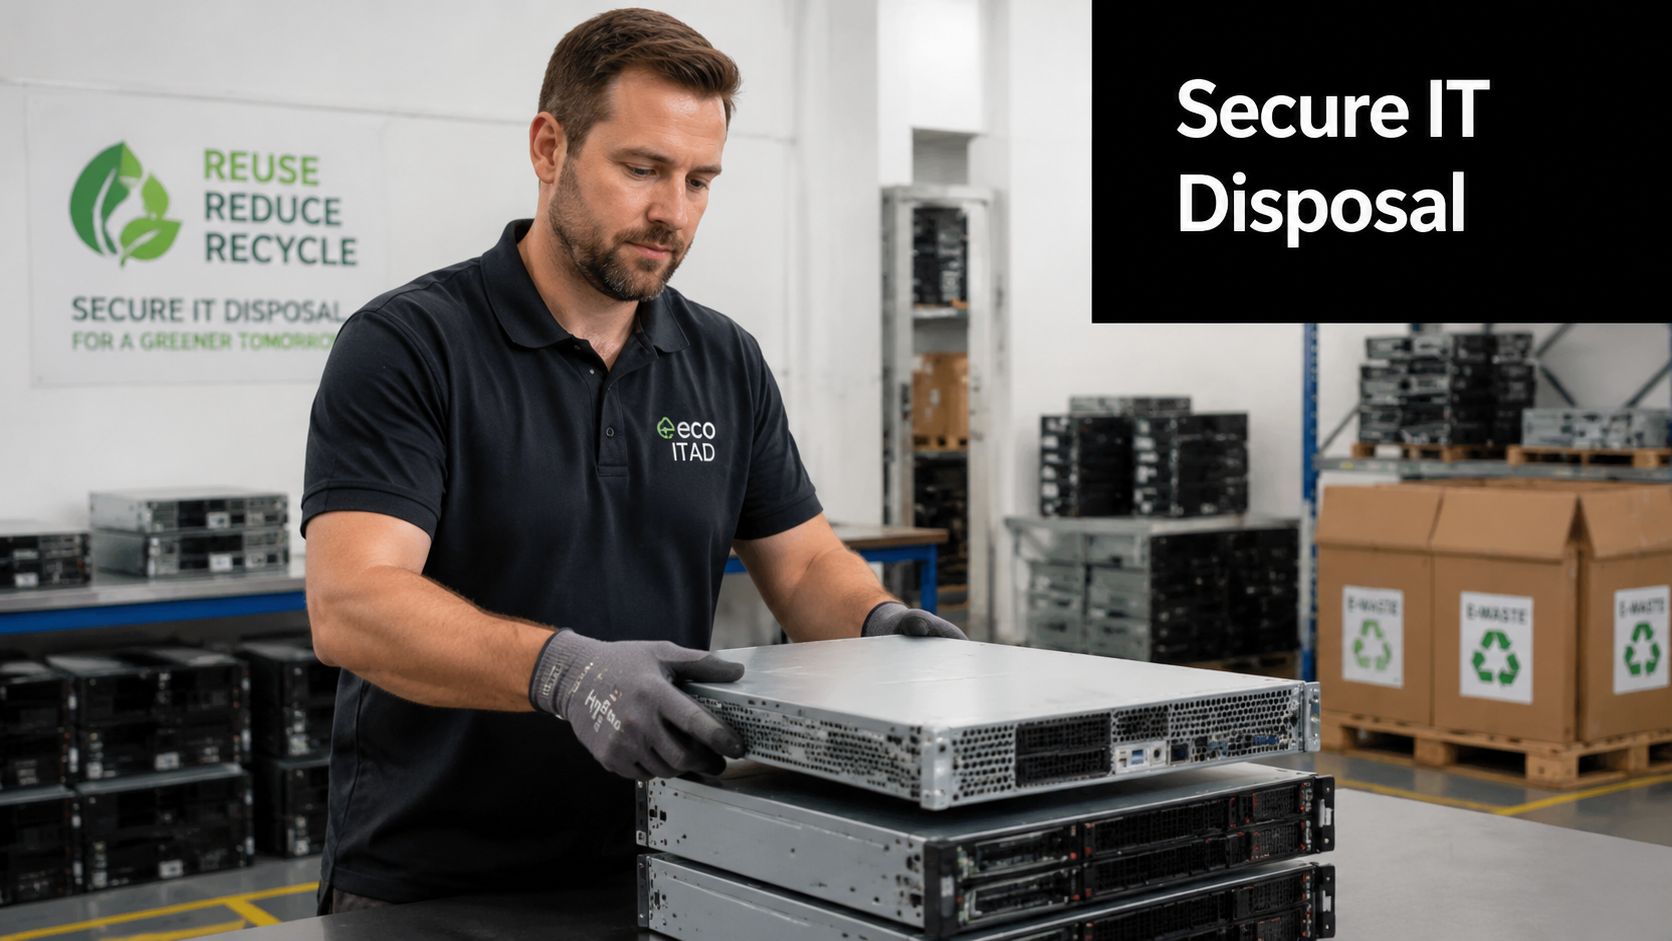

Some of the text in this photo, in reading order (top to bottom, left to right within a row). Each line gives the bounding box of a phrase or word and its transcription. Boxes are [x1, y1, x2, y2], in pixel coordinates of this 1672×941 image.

[203, 149, 319, 186] REUSE
[204, 191, 342, 226] REDUCE
[205, 232, 358, 266] RECYCLE
[72, 296, 346, 323] SECURE IT DISPOSAL
[72, 332, 113, 351] FOR
[120, 332, 134, 350] A
[140, 332, 232, 351] GREENER
[677, 421, 716, 440] eco
[671, 442, 715, 462] ITAD
[1466, 603, 1528, 625] E-WASTE
